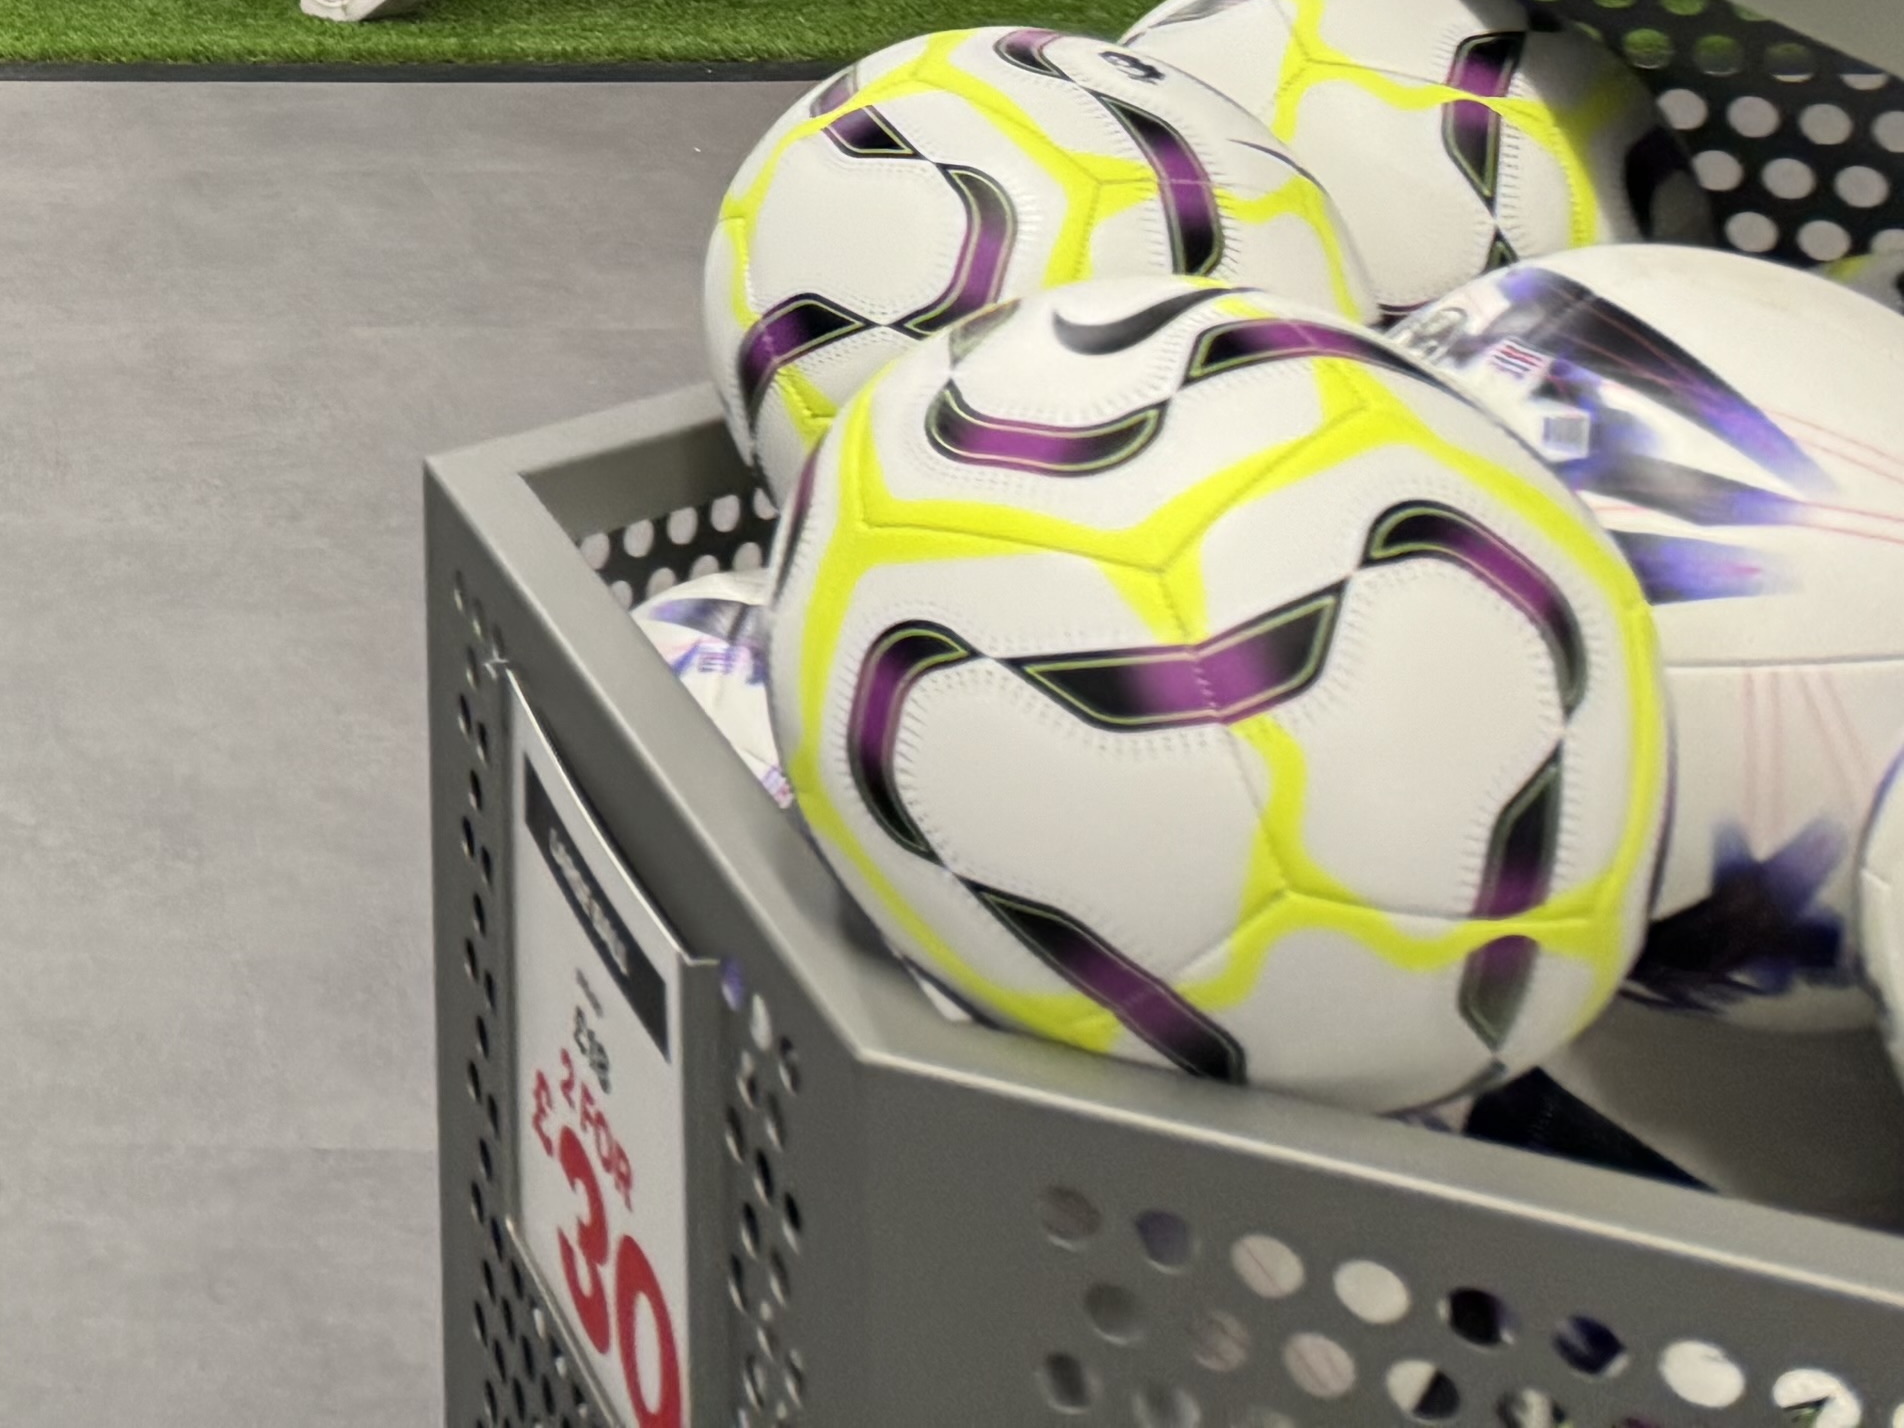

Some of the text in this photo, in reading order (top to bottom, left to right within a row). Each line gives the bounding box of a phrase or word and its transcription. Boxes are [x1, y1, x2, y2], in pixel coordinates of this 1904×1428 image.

[532, 1069, 682, 1428] £30
[560, 1048, 633, 1213] 2 FOR
